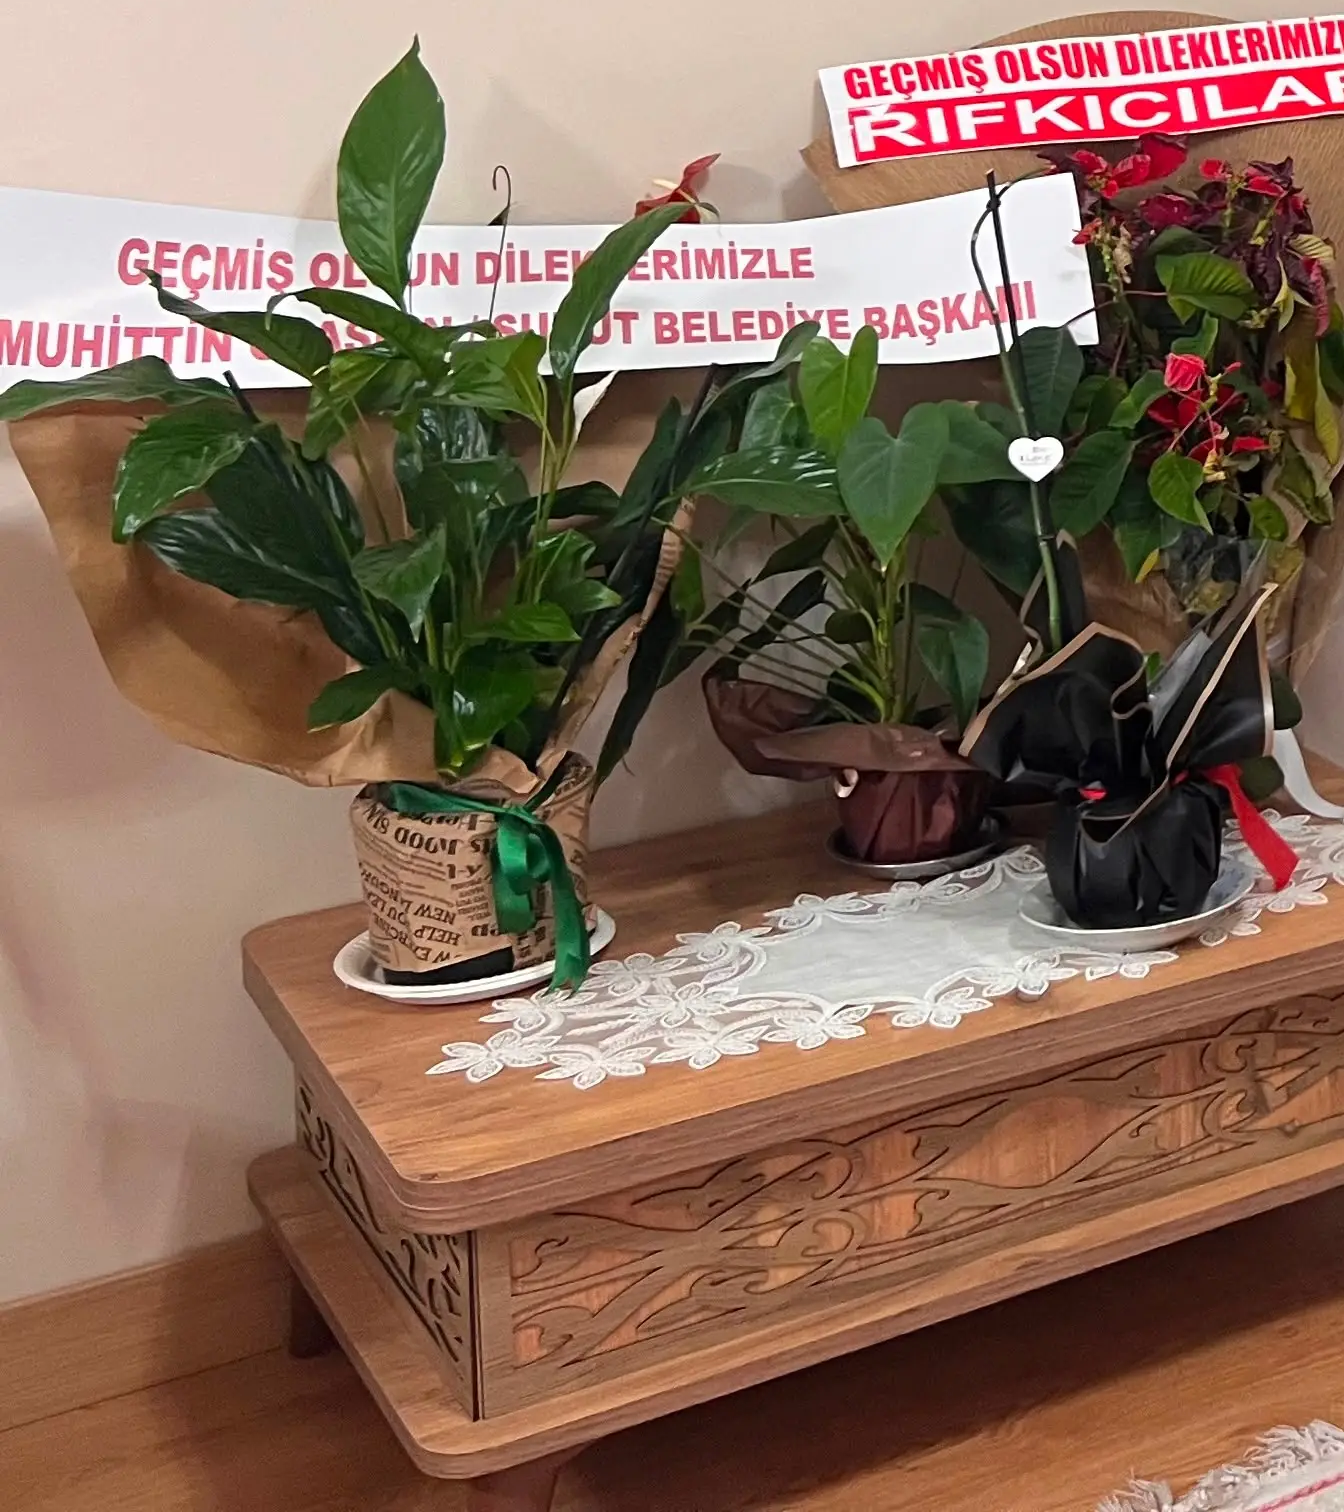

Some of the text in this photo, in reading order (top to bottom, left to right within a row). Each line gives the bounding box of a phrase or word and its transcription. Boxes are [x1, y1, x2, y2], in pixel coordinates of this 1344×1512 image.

[844, 50, 989, 100] GEÇMİŞ
[995, 42, 1109, 85] OLSUN
[414, 925, 462, 946] HELP
